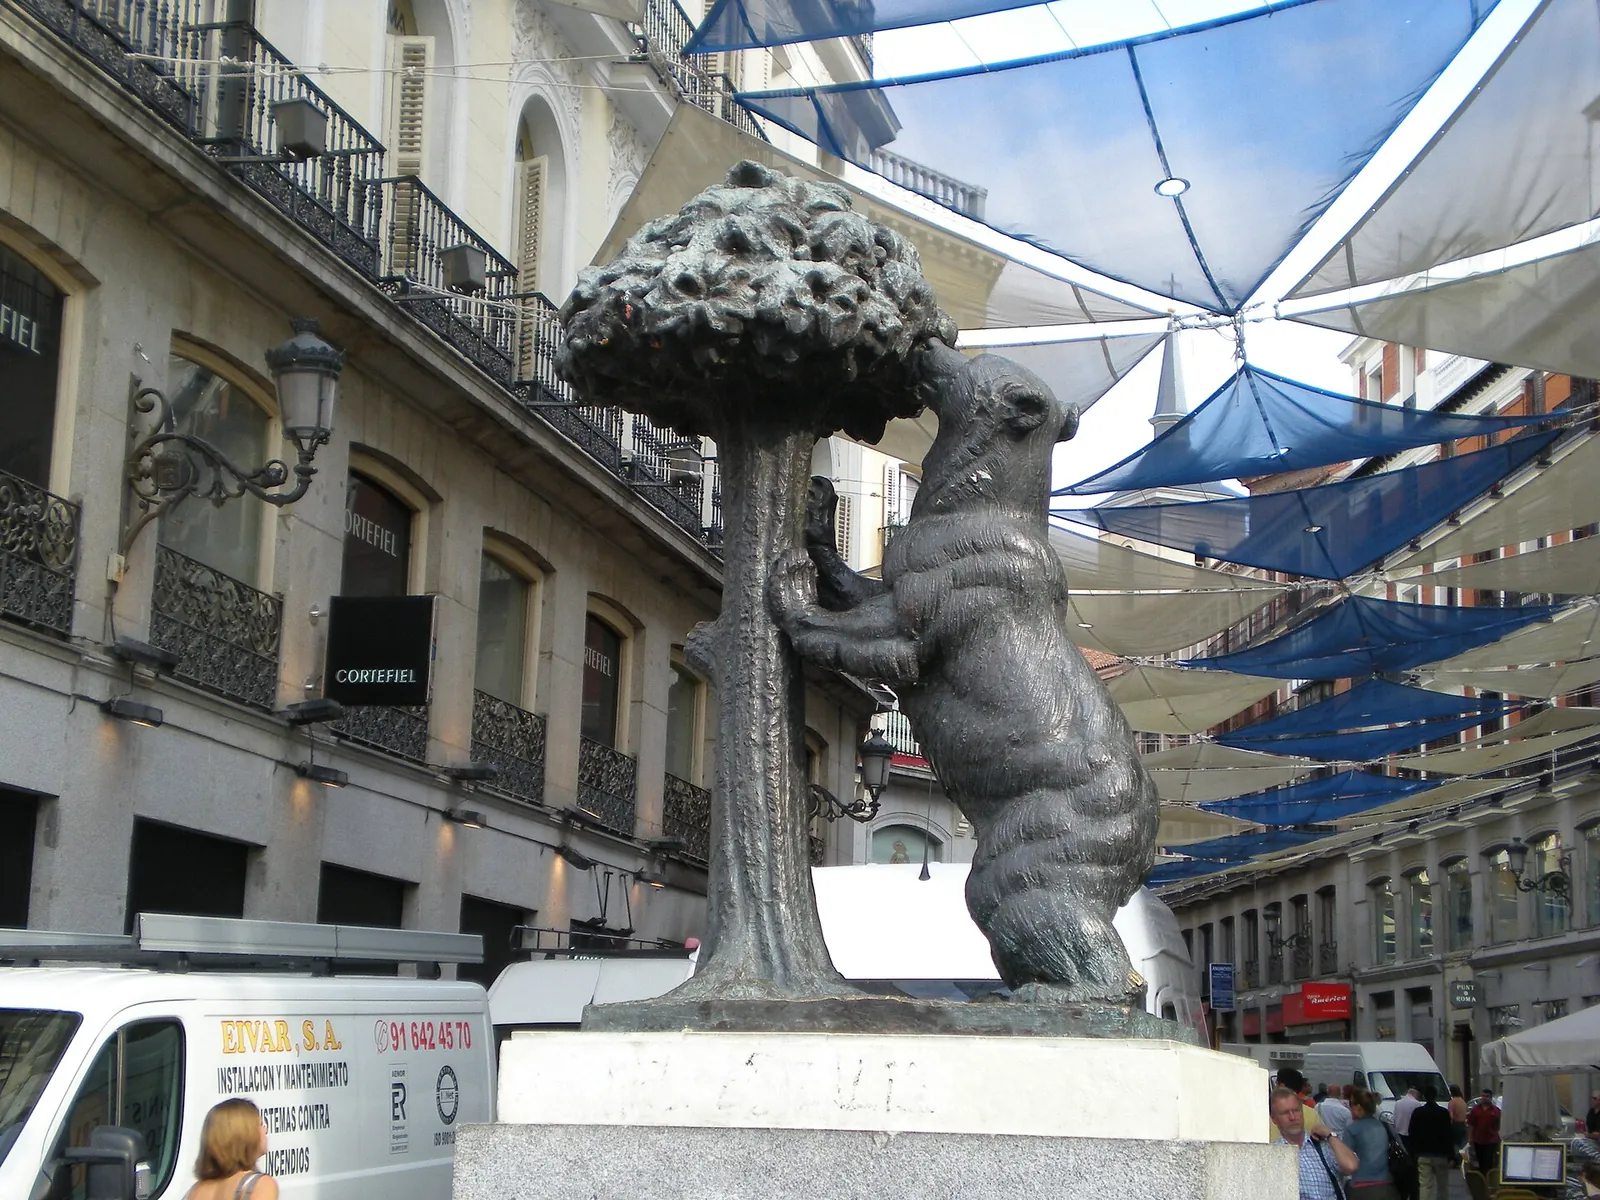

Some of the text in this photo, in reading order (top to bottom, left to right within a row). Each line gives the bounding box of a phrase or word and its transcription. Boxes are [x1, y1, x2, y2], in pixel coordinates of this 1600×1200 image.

[0, 304, 41, 354] FIEL
[335, 669, 417, 684] CORTEFIEL
[390, 1022, 471, 1052] 91 642 45 70
[217, 1061, 349, 1094] INSTALACION Y MANTENIMIENTO
[298, 1103, 331, 1132] CONTRA
[265, 1146, 310, 1178] INCENDIOS
